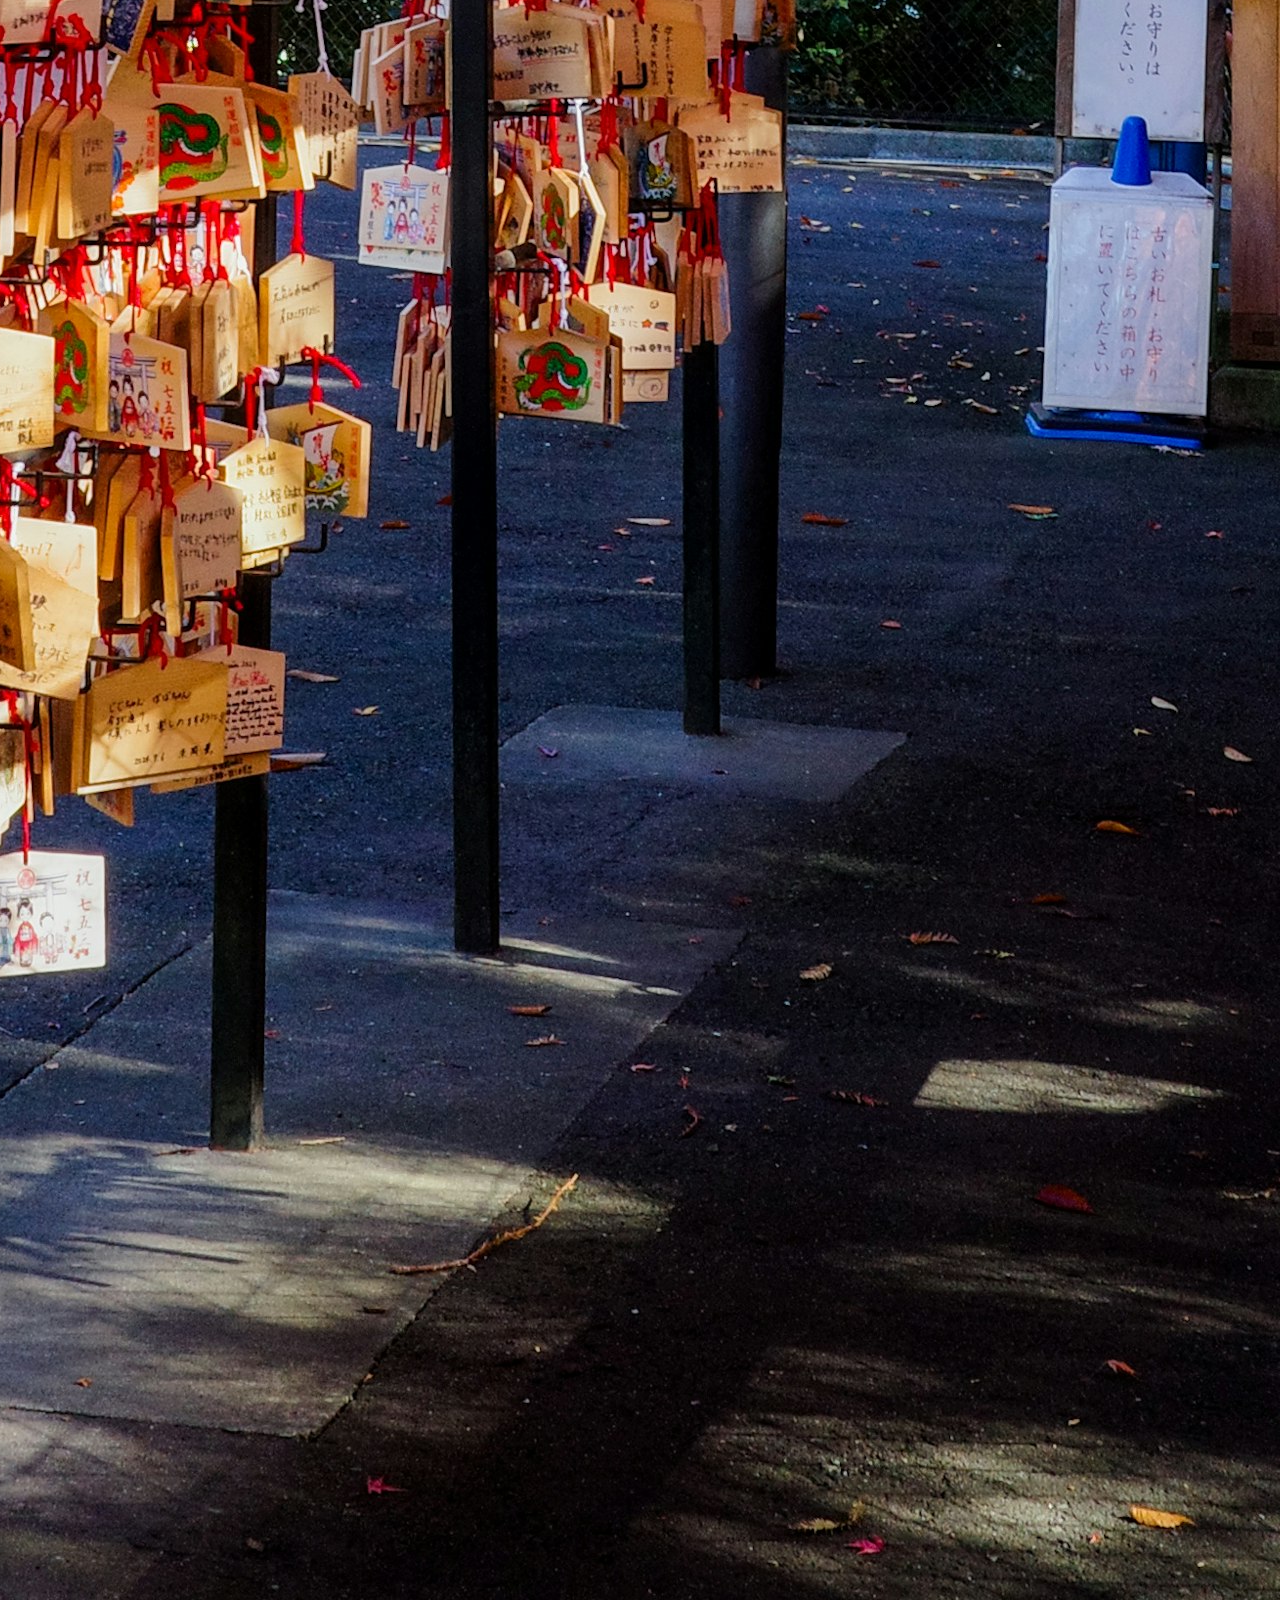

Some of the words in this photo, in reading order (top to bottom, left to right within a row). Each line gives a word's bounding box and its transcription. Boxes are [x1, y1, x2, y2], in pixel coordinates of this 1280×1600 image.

[1094, 226, 1114, 372] に置いてください
[1120, 226, 1140, 382] はこちらの箱の中
[1147, 227, 1166, 383] 古いお札・お守り
